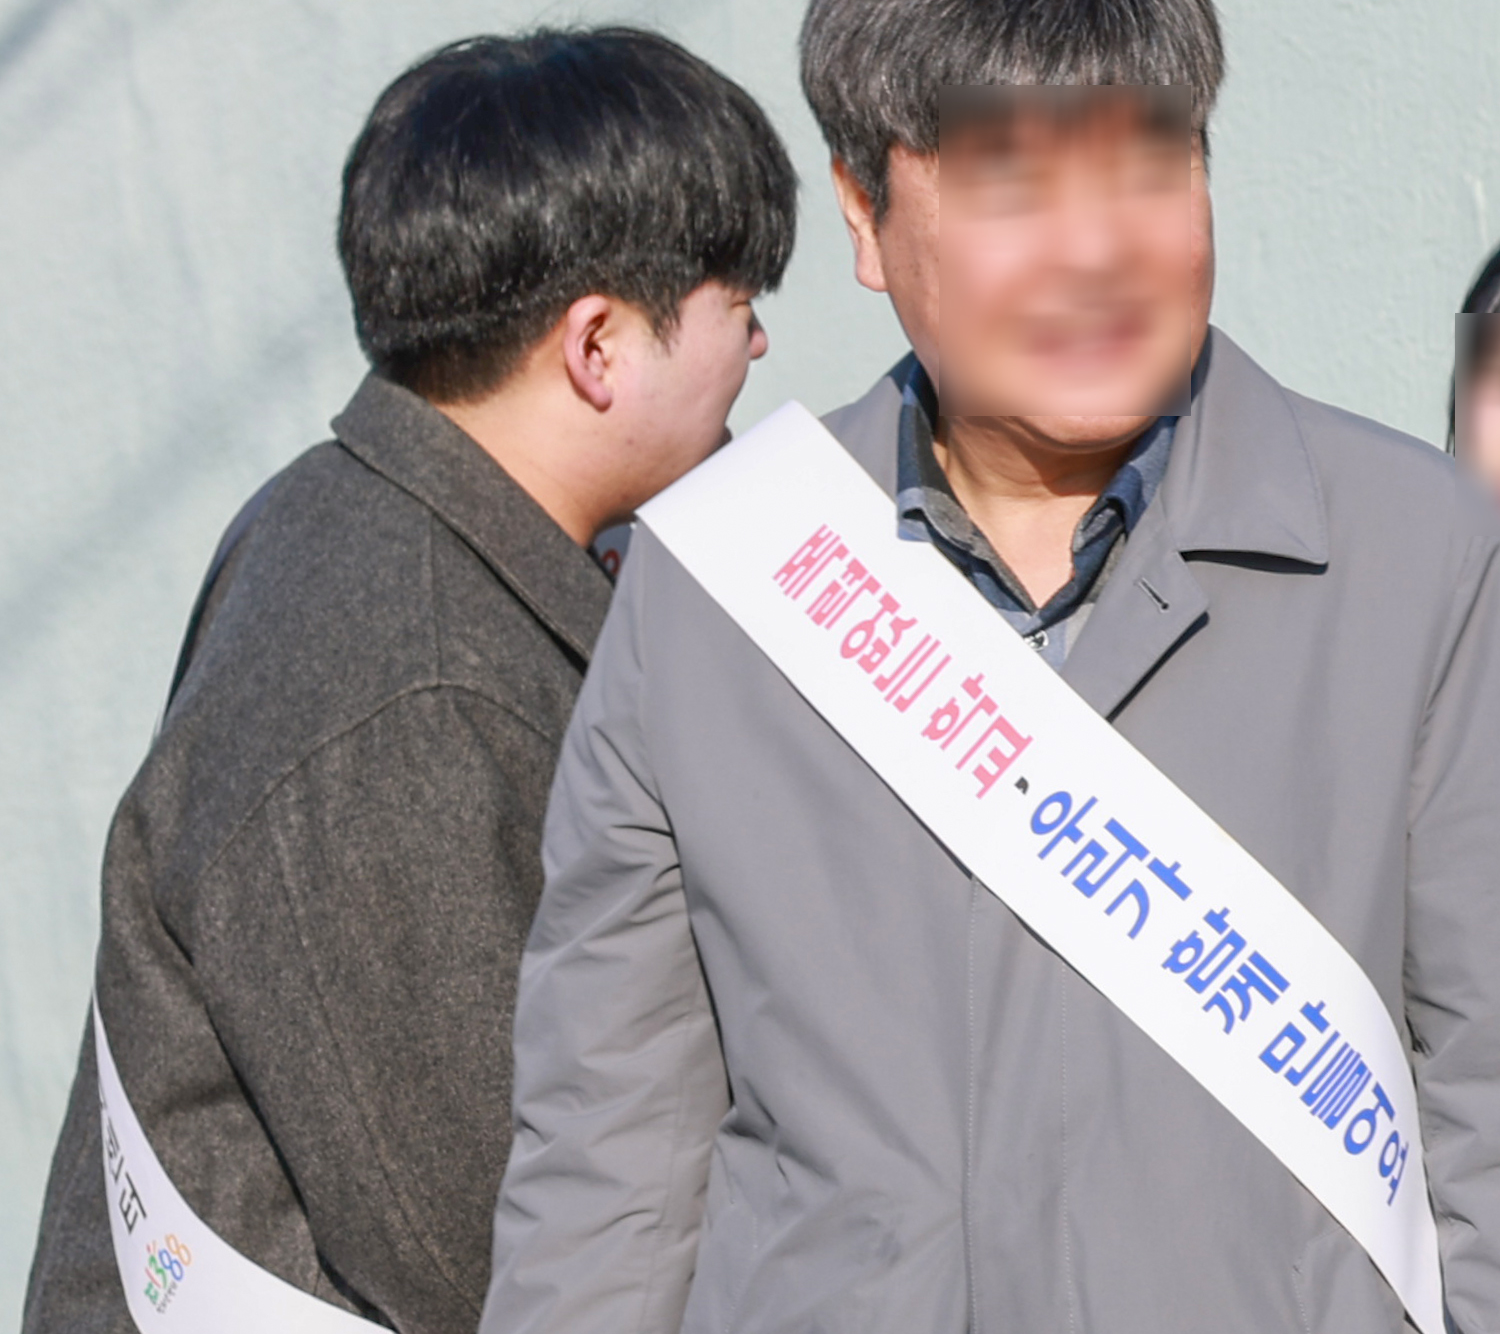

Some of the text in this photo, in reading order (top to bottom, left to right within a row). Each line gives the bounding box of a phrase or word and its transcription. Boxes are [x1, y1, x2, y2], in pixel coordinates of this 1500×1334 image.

[773, 524, 952, 713] 폭력없는
[1029, 789, 1193, 939] 우리가
[1161, 907, 1291, 1034] 함께
[1258, 1001, 1409, 1205] 만들어요
